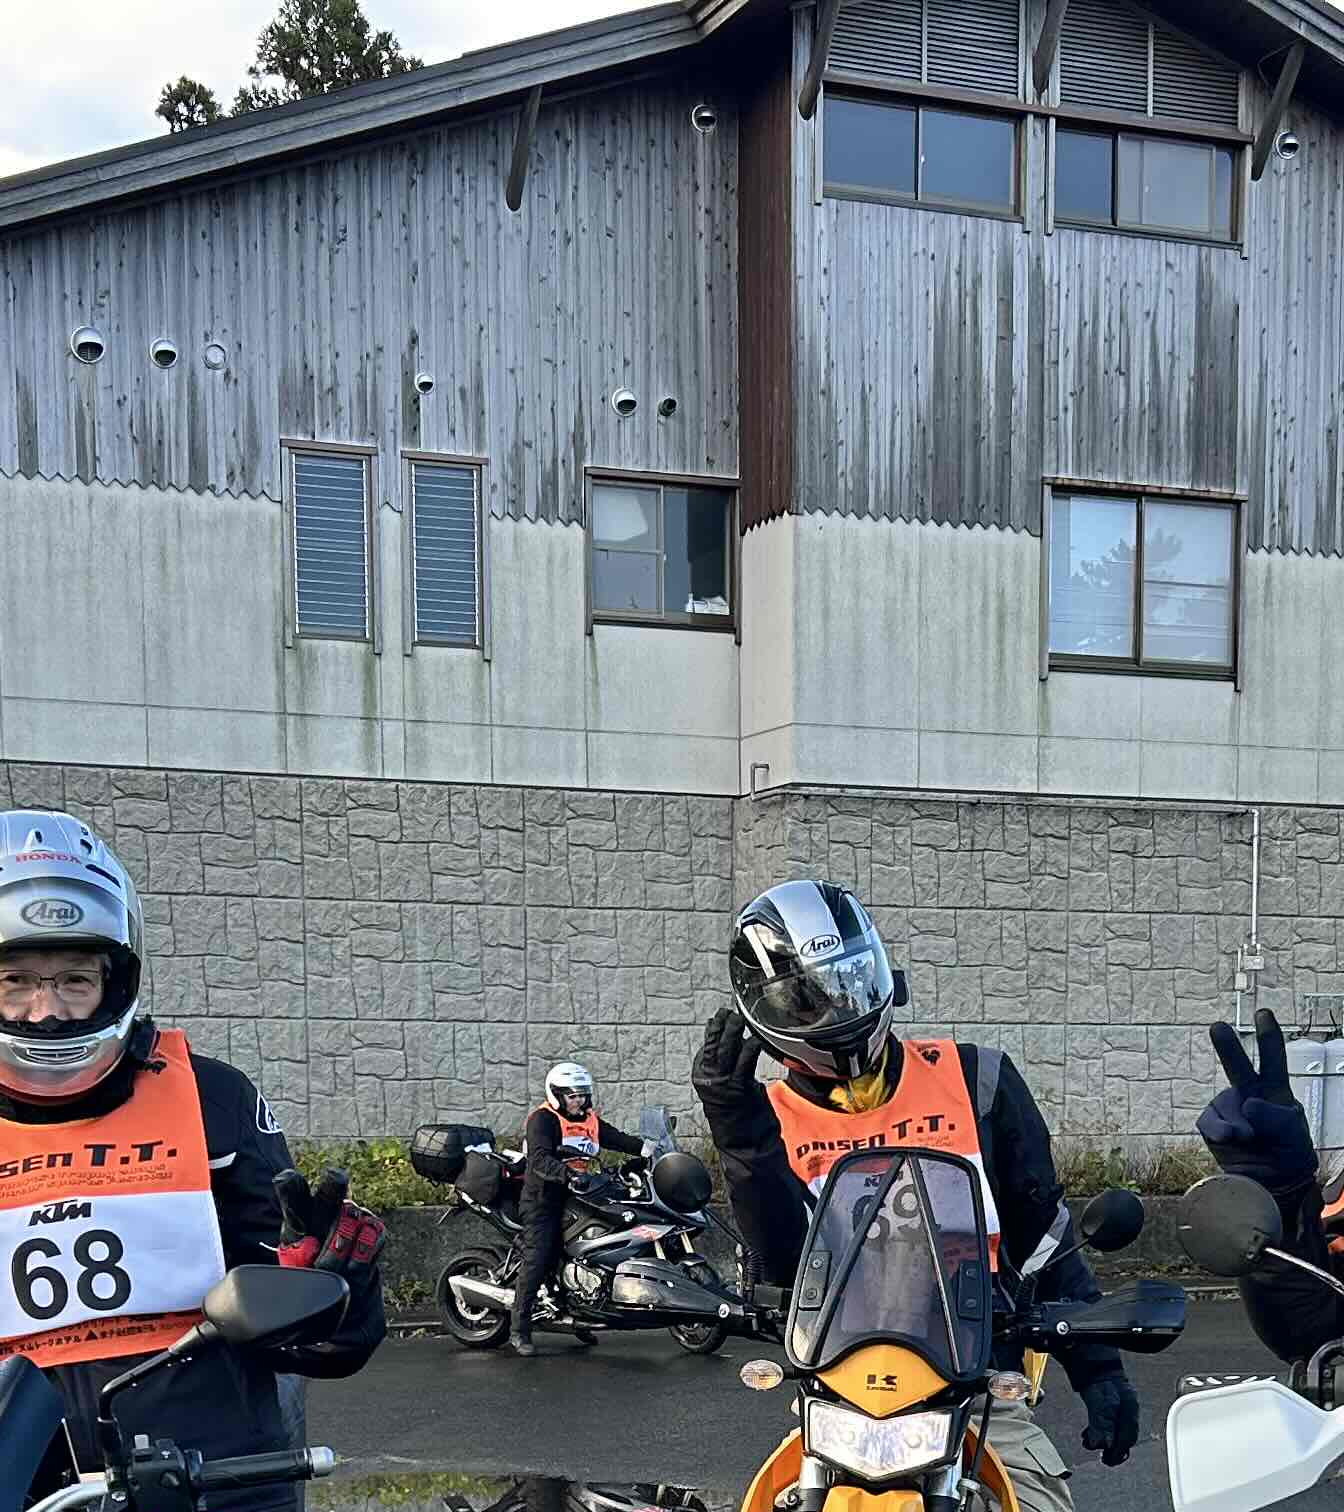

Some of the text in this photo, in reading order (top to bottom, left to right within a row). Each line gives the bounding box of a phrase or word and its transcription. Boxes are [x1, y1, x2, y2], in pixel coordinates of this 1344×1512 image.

[24, 901, 77, 921] Arai
[804, 936, 837, 955] Arai
[28, 1199, 92, 1226] KTM
[11, 1229, 132, 1320] 68
